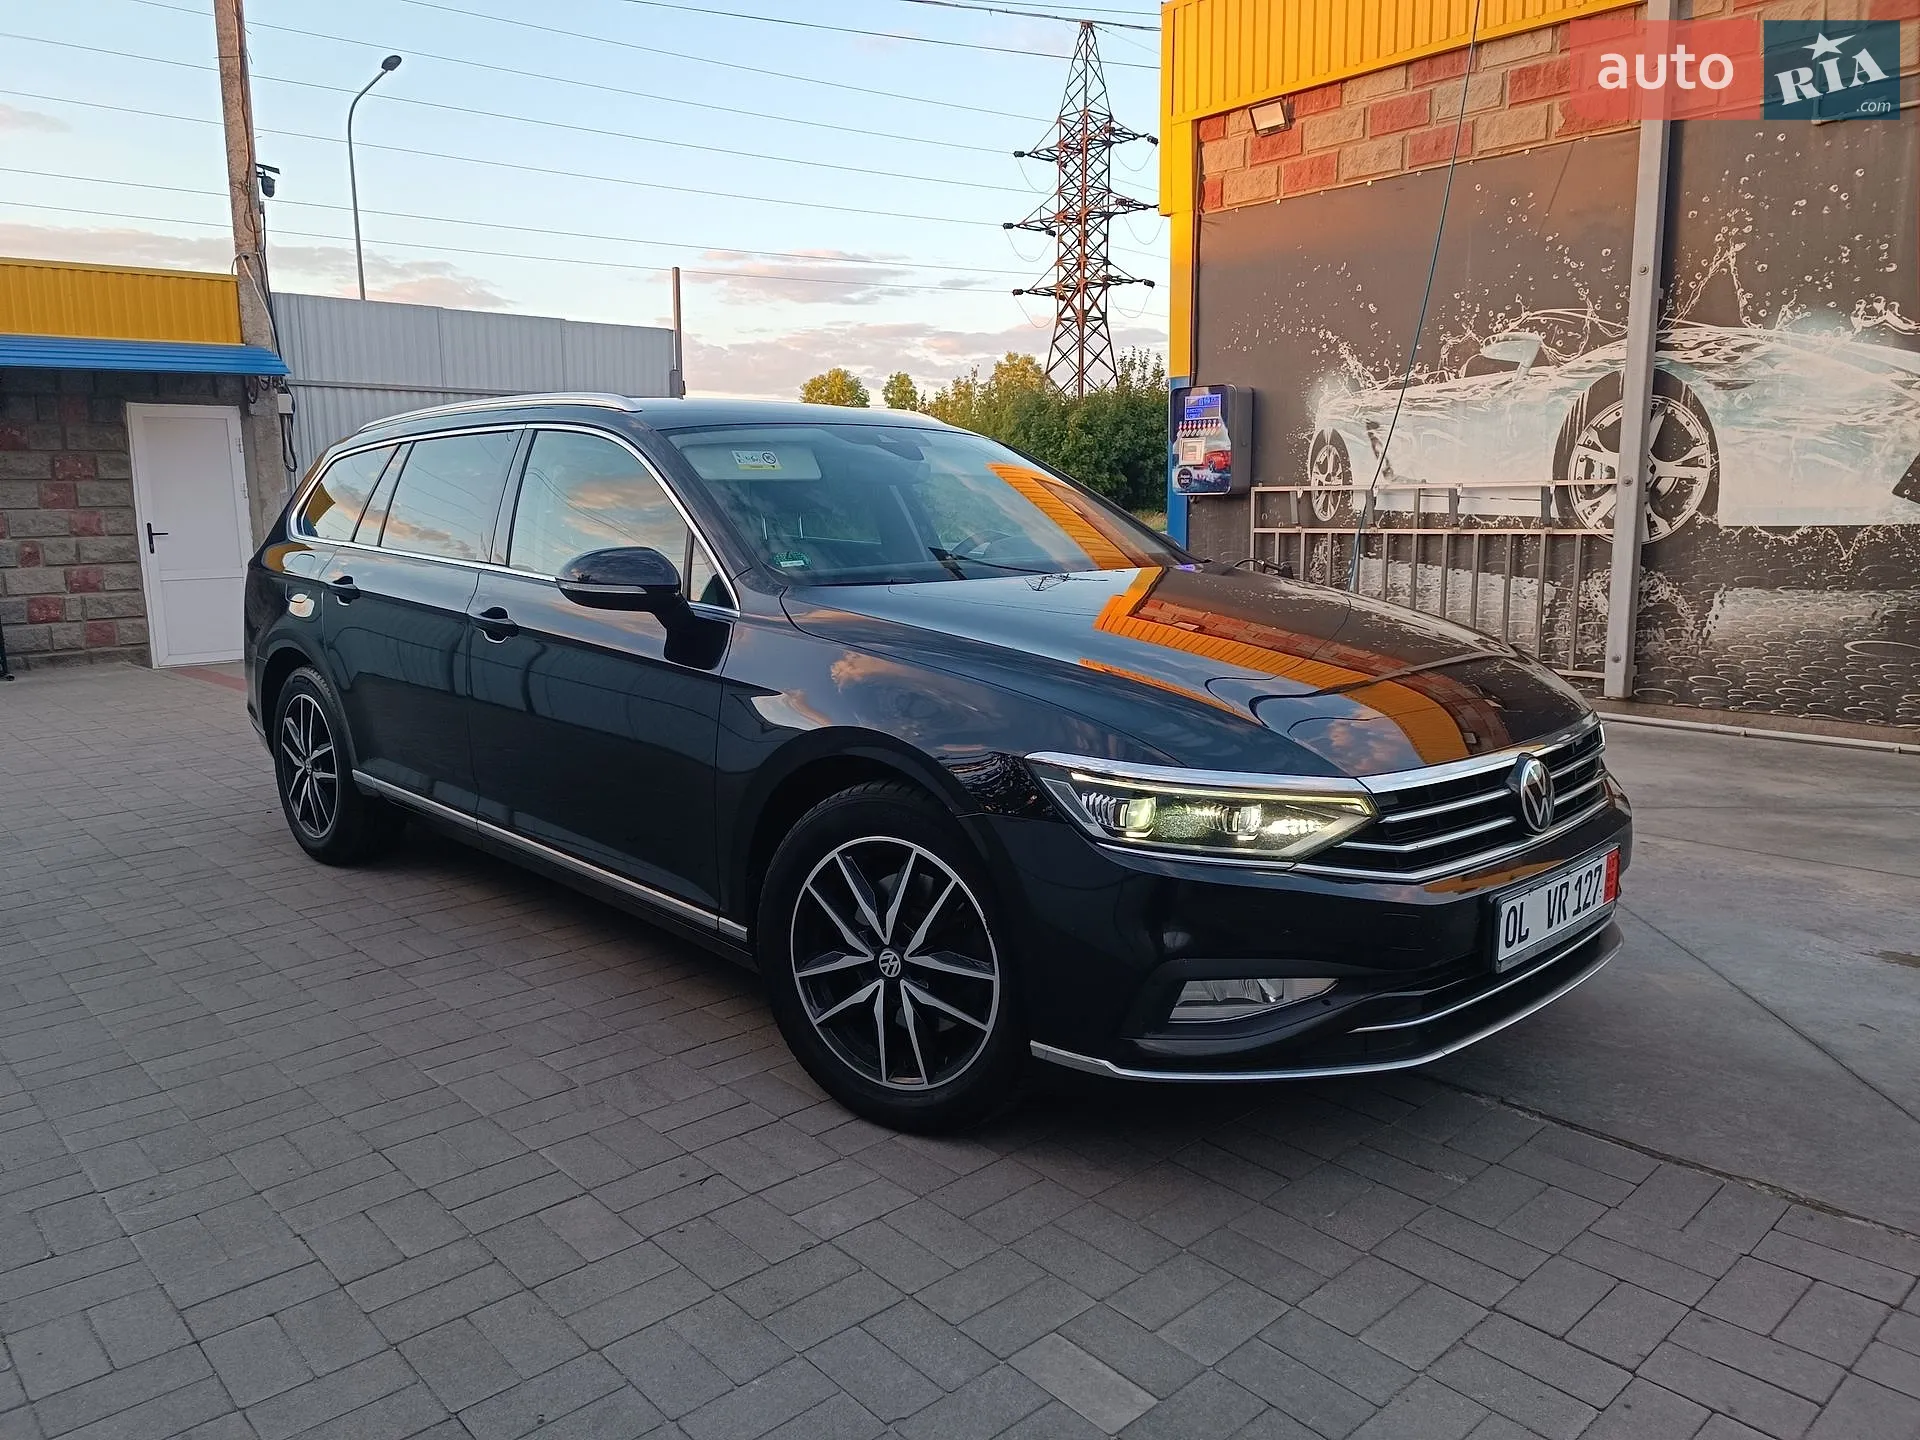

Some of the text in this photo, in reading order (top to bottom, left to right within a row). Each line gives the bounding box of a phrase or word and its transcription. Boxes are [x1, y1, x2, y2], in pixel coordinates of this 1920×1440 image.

[1505, 901, 1530, 949] OL
[1547, 881, 1570, 929] VR
[1572, 863, 1603, 917] 127
